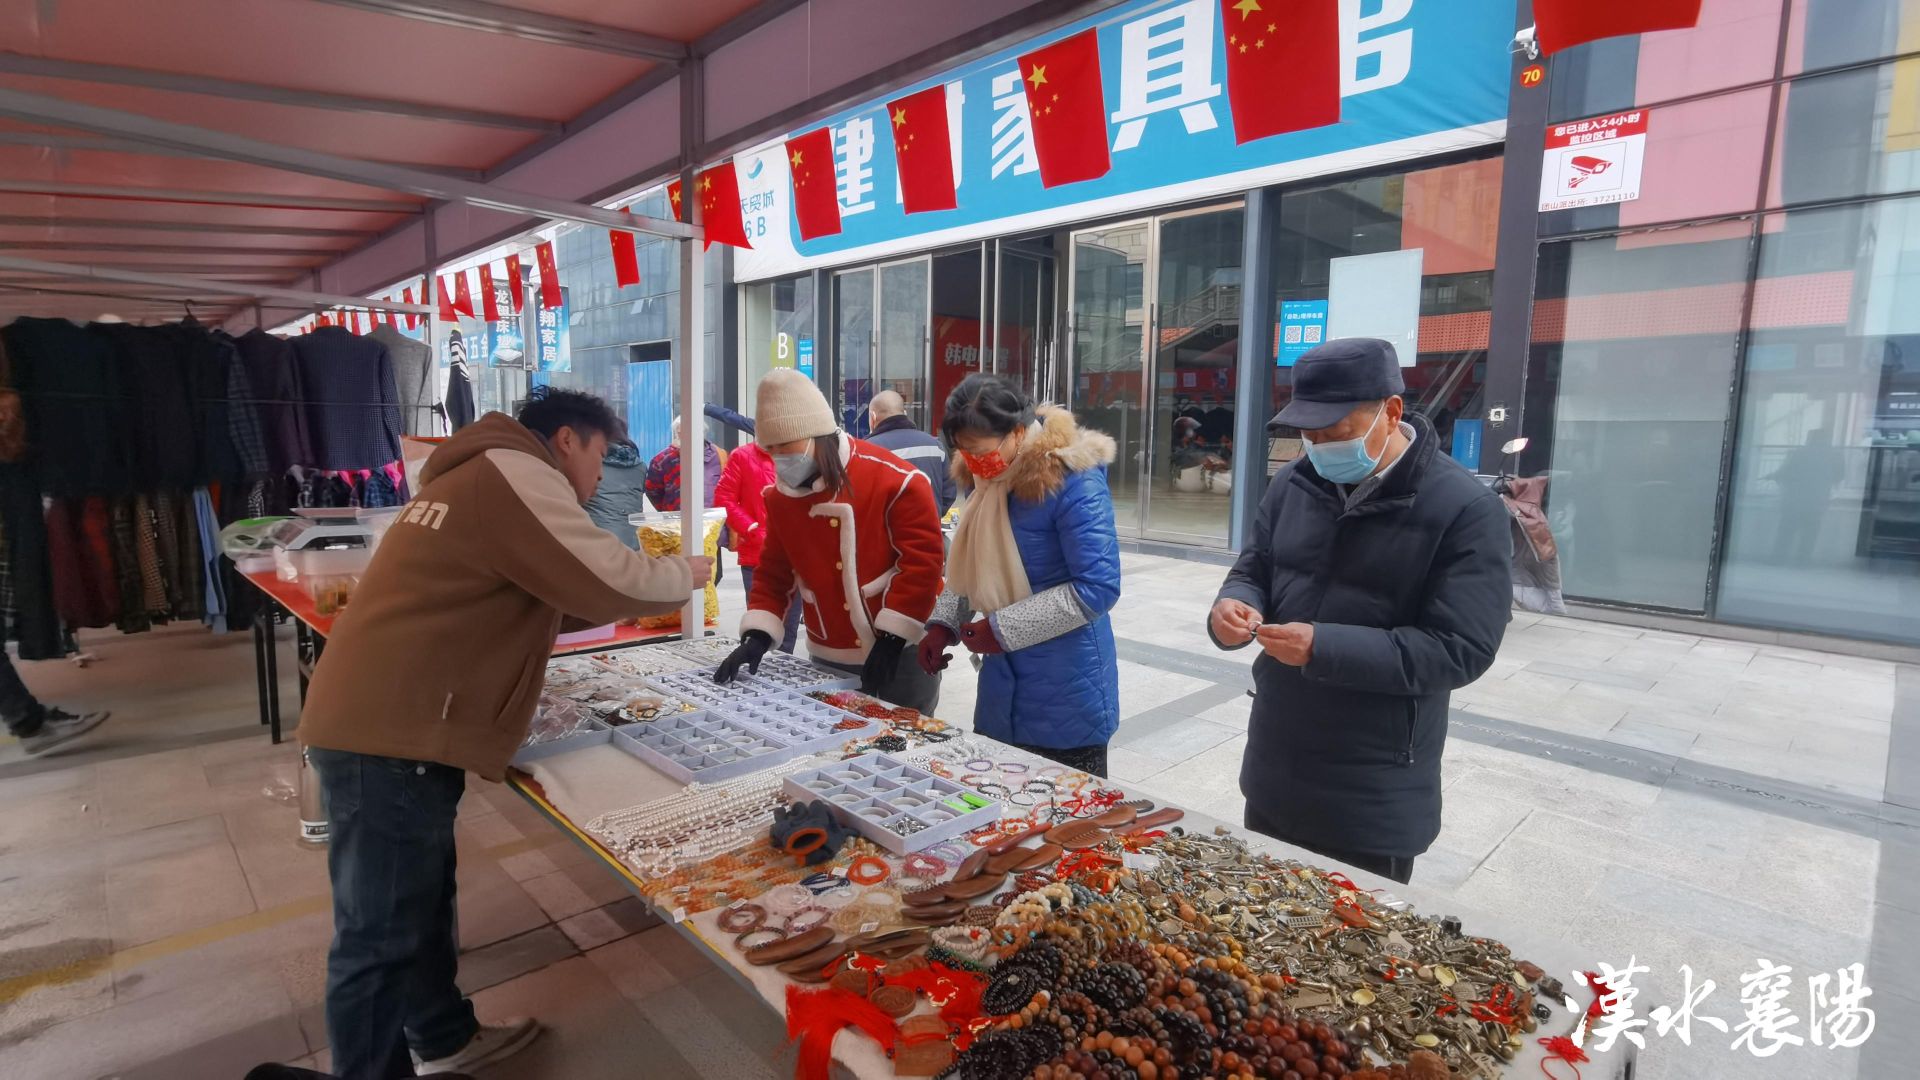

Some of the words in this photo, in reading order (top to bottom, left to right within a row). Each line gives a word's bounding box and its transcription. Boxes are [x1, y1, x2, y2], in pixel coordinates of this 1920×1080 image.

[1522, 69, 1541, 85] 70
[1554, 112, 1641, 137] 您已进入24小时
[1569, 129, 1618, 146] 监控区域
[1593, 192, 1635, 204] 3721110
[539, 294, 557, 362] 翔家居
[777, 332, 789, 359] B
